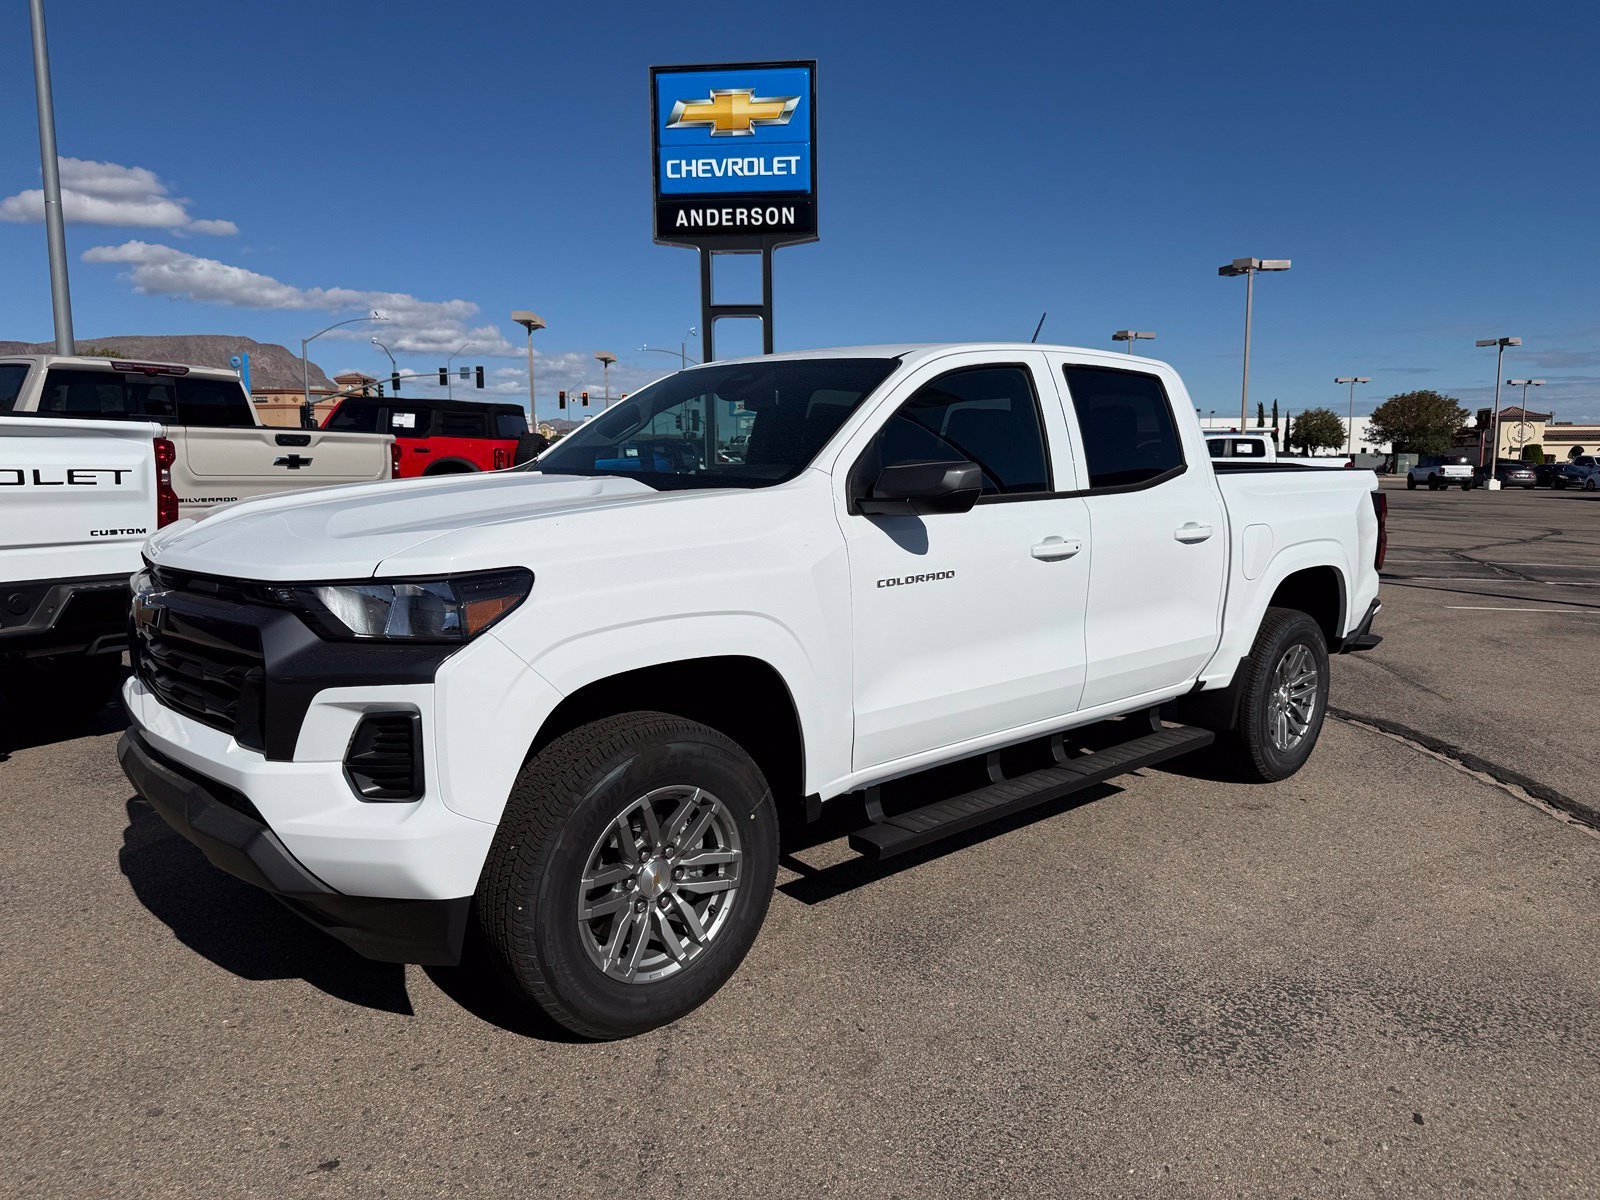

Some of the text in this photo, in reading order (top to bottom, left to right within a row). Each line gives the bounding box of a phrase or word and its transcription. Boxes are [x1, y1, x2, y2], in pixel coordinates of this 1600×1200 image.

[666, 156, 801, 179] CHEVROLET
[675, 206, 796, 227] ANDERSON
[178, 496, 238, 504] SILVERADO
[90, 528, 147, 537] CUSTOM
[877, 570, 955, 589] COLORADO
